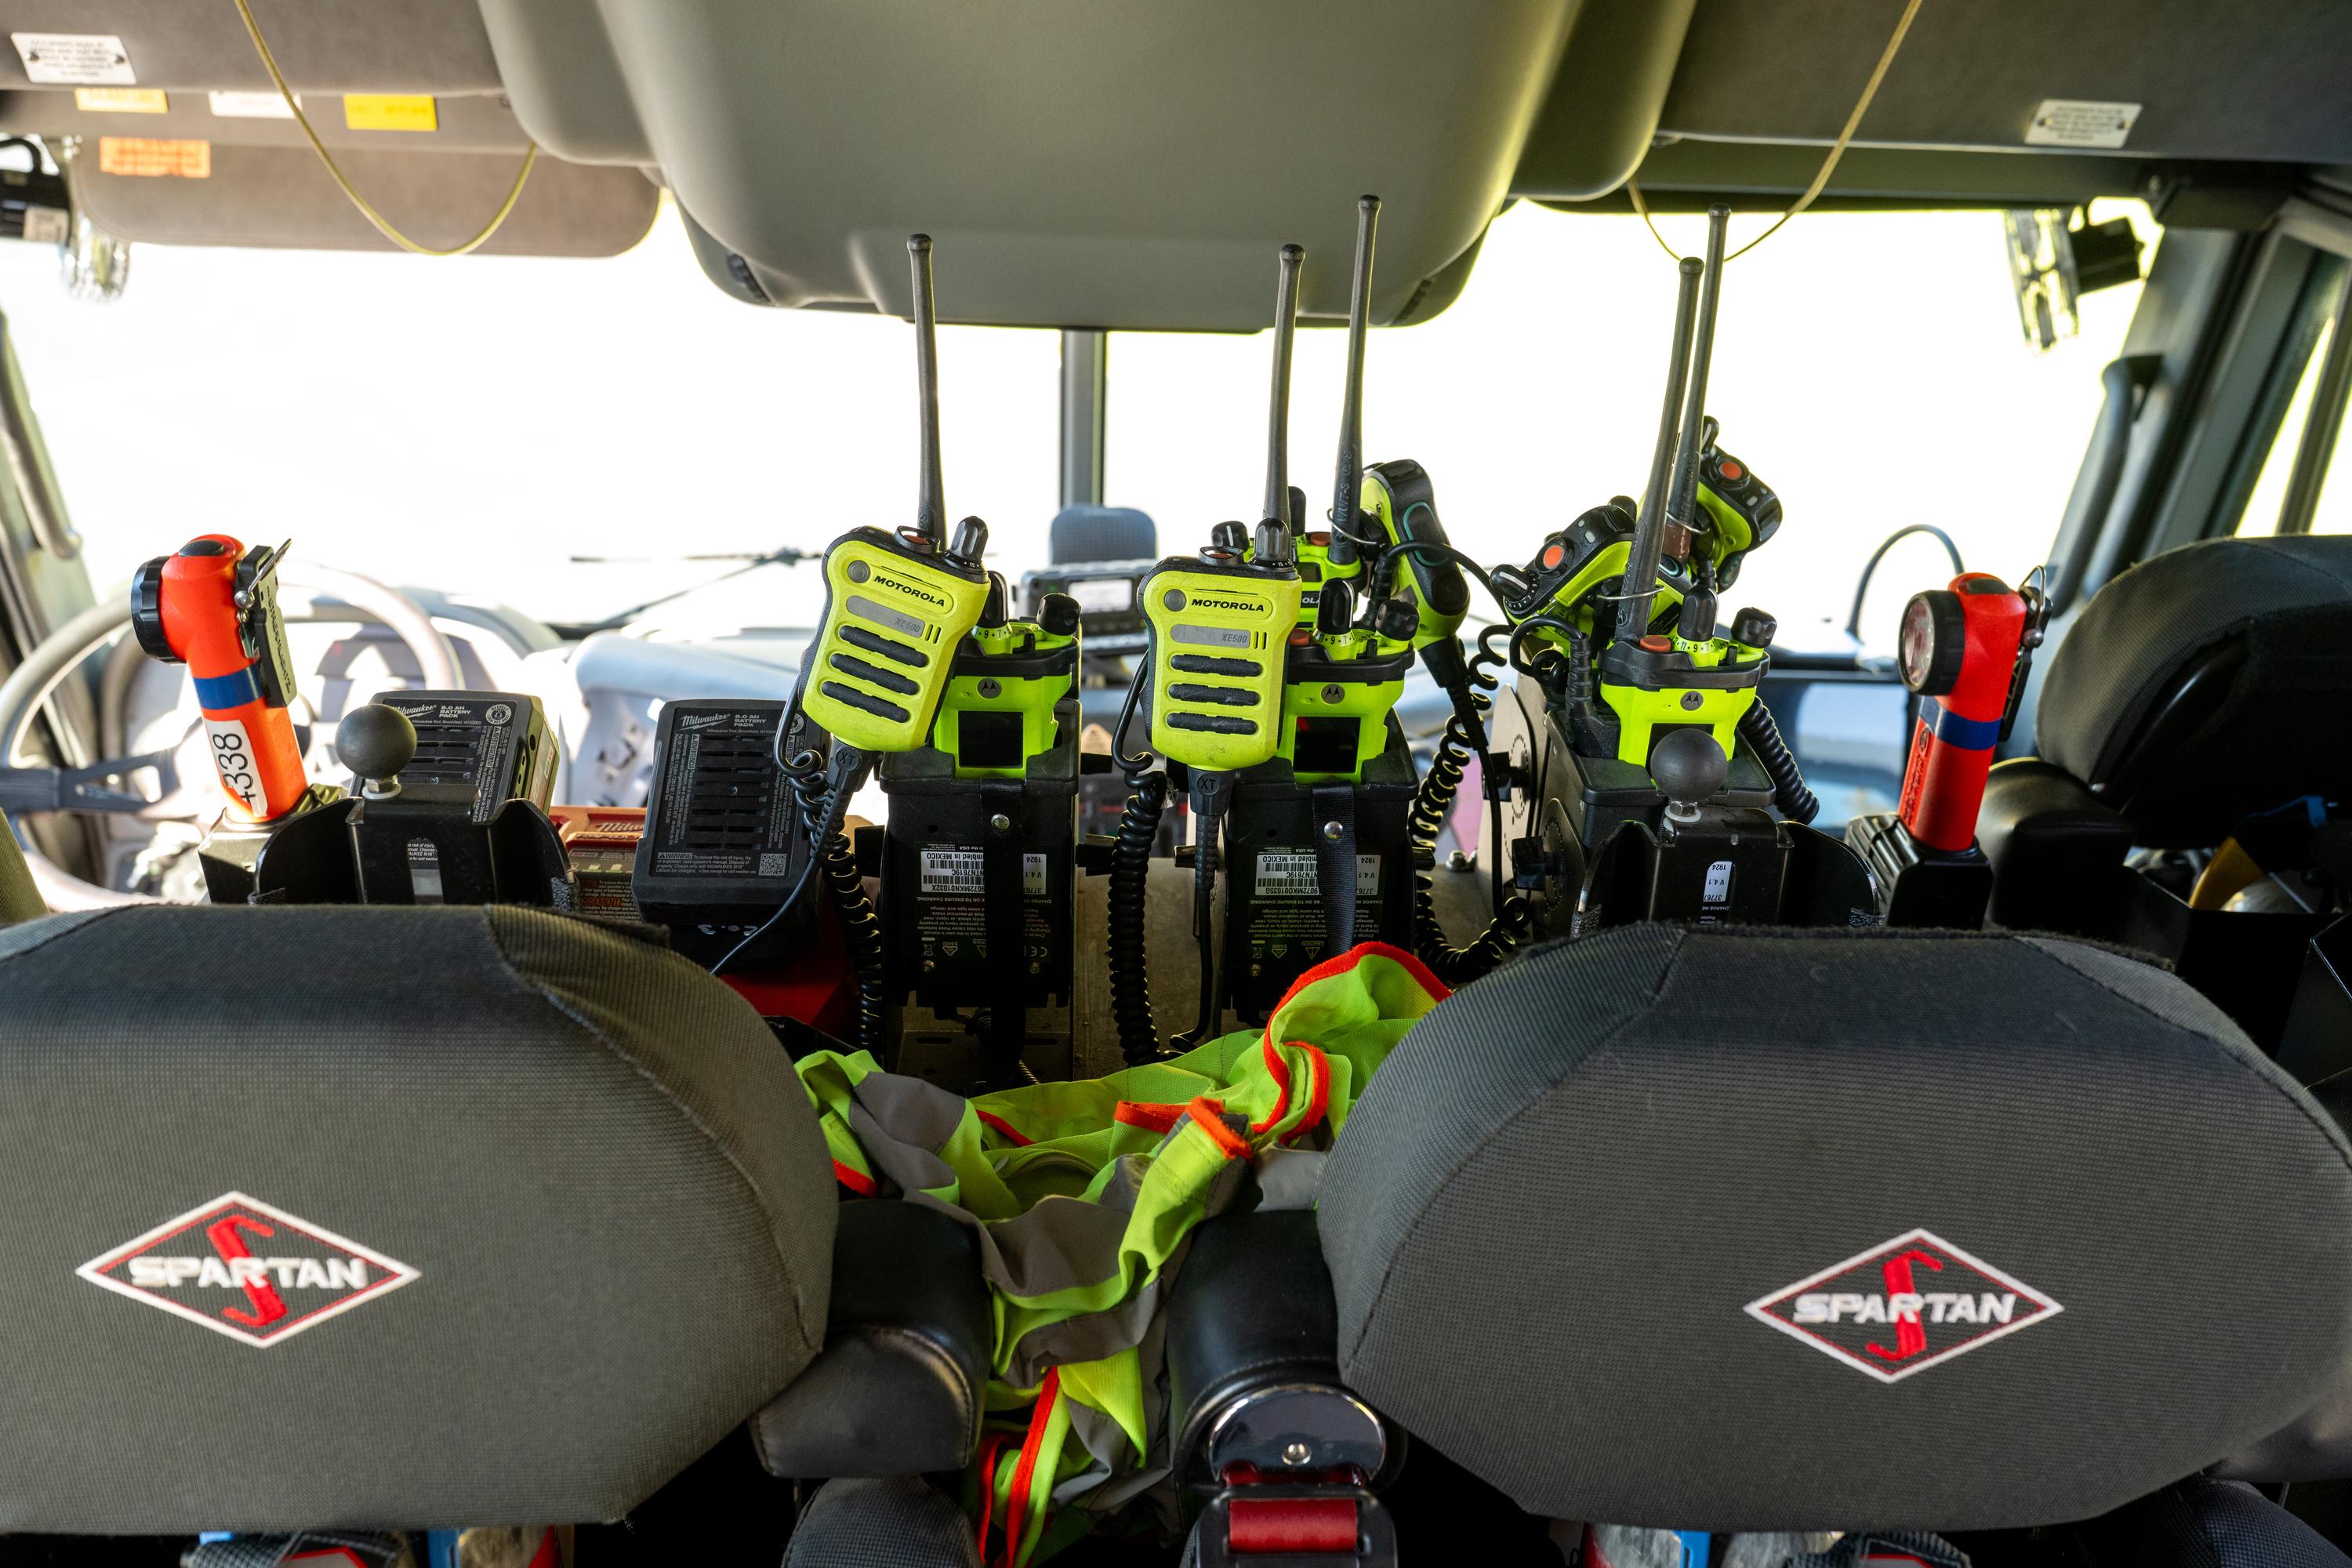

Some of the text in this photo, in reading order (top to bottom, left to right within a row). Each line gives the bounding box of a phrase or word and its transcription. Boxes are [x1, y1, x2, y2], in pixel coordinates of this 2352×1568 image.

[874, 575, 945, 608] MOTOROLA
[1192, 598, 1265, 612] MOTOROLA
[894, 617, 920, 633] XE500
[984, 629, 1002, 639] 9 7
[1221, 633, 1247, 644] XE500
[1330, 636, 1335, 645] 9
[1693, 644, 1698, 653] 9
[680, 713, 728, 727] Milwaukee
[840, 752, 856, 766] XT
[1200, 778, 1217, 791] XT
[128, 1256, 368, 1288] SPARTAN
[1793, 1293, 2016, 1323] SPARTAN
